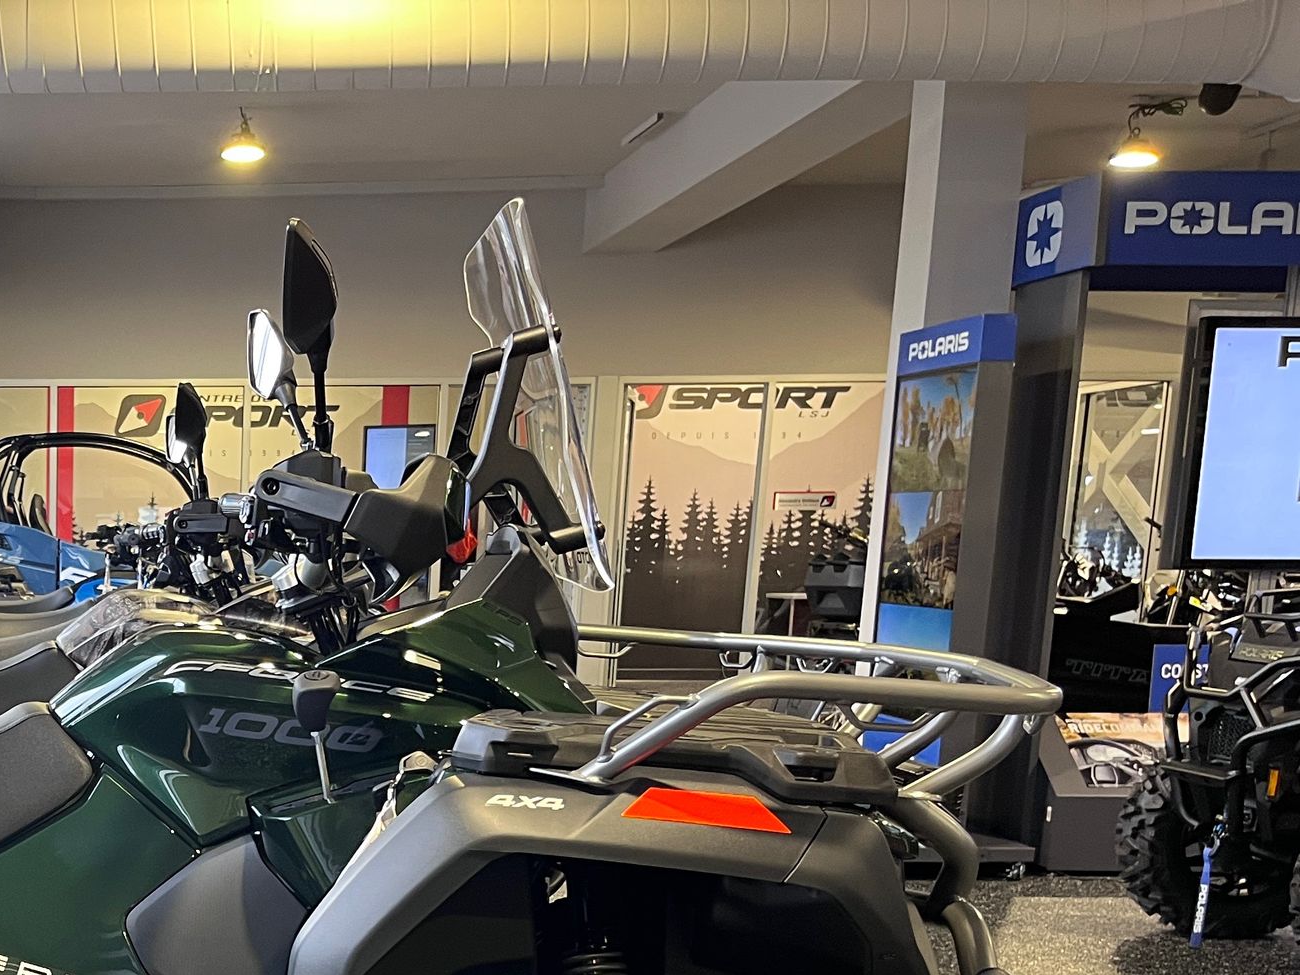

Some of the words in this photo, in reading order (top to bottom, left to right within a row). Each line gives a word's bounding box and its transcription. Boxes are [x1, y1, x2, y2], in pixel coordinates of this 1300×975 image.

[1124, 201, 1300, 235] POLA
[908, 331, 969, 361] POLARIS
[798, 410, 830, 418] LSJ
[651, 431, 730, 440] DEPUIS
[752, 431, 802, 439] 194
[163, 660, 435, 702] CFOCE
[1066, 658, 1151, 684] TITA
[200, 707, 384, 754] 1000
[484, 794, 565, 811] 4X4
